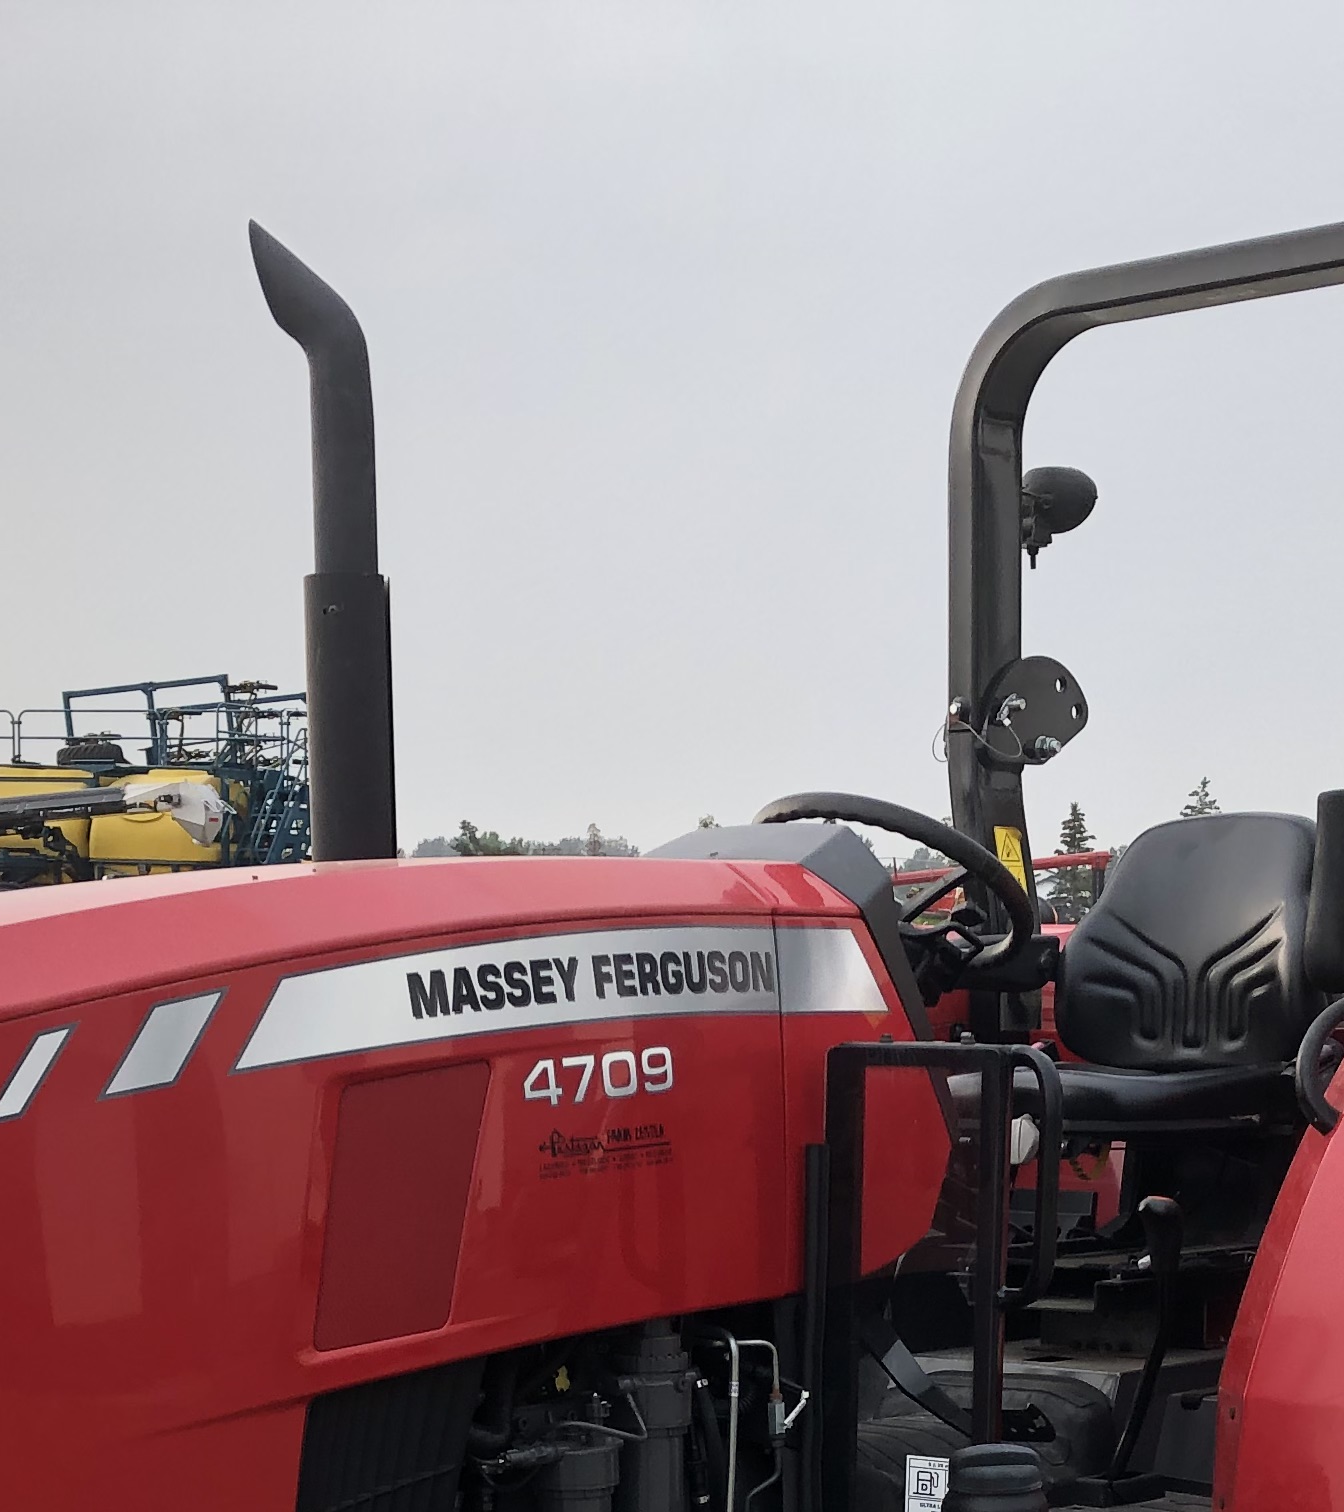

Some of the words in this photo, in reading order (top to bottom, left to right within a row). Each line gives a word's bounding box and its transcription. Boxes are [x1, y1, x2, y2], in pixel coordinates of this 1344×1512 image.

[406, 957, 579, 1020] MASSEY
[591, 950, 776, 999] FERGUSON
[523, 1046, 674, 1106] 4709
